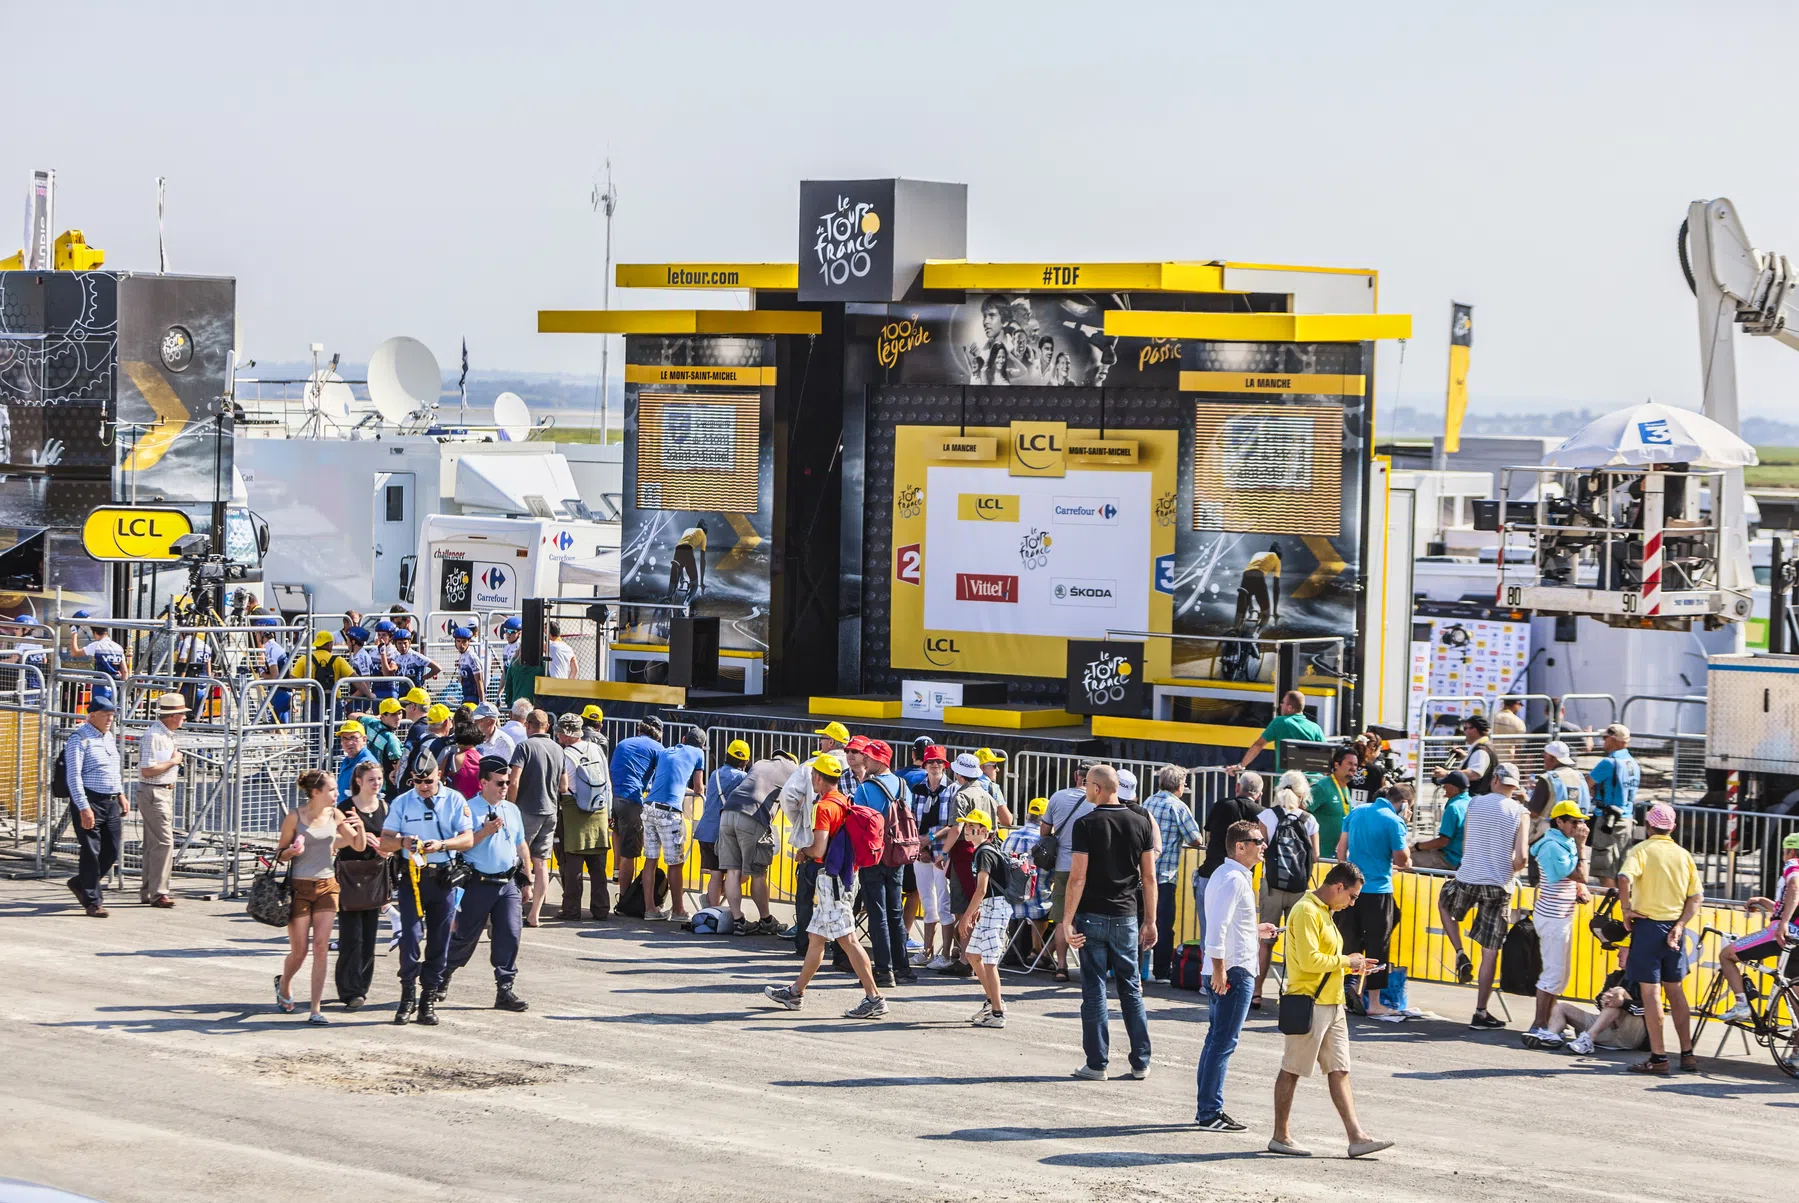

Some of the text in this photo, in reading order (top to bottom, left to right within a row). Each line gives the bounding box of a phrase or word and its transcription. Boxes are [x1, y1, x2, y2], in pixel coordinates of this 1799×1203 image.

[667, 266, 739, 285] letour.com
[819, 251, 871, 286] 100
[1042, 266, 1080, 285] #TDF
[881, 313, 919, 339] 100%
[660, 371, 737, 381] LE MONT-SAINT-MICHEL
[1245, 378, 1292, 389] LA MANCHE
[943, 443, 977, 453] LA MANCHE
[1018, 434, 1062, 452] LCL
[1068, 446, 1131, 457] MONT-SAINT-MICHEL
[978, 498, 1003, 510] LCL
[1055, 506, 1095, 516] Carrefour
[118, 518, 162, 537] LCL
[902, 551, 920, 578] 2
[1022, 555, 1048, 570] 100
[969, 579, 1003, 597] Vittel
[1070, 586, 1113, 598] ŠKODA
[1507, 586, 1521, 606] 80
[477, 593, 508, 603] Carrefour
[1622, 593, 1637, 613] 90
[927, 638, 960, 653] LCL
[1086, 685, 1125, 706] 100
